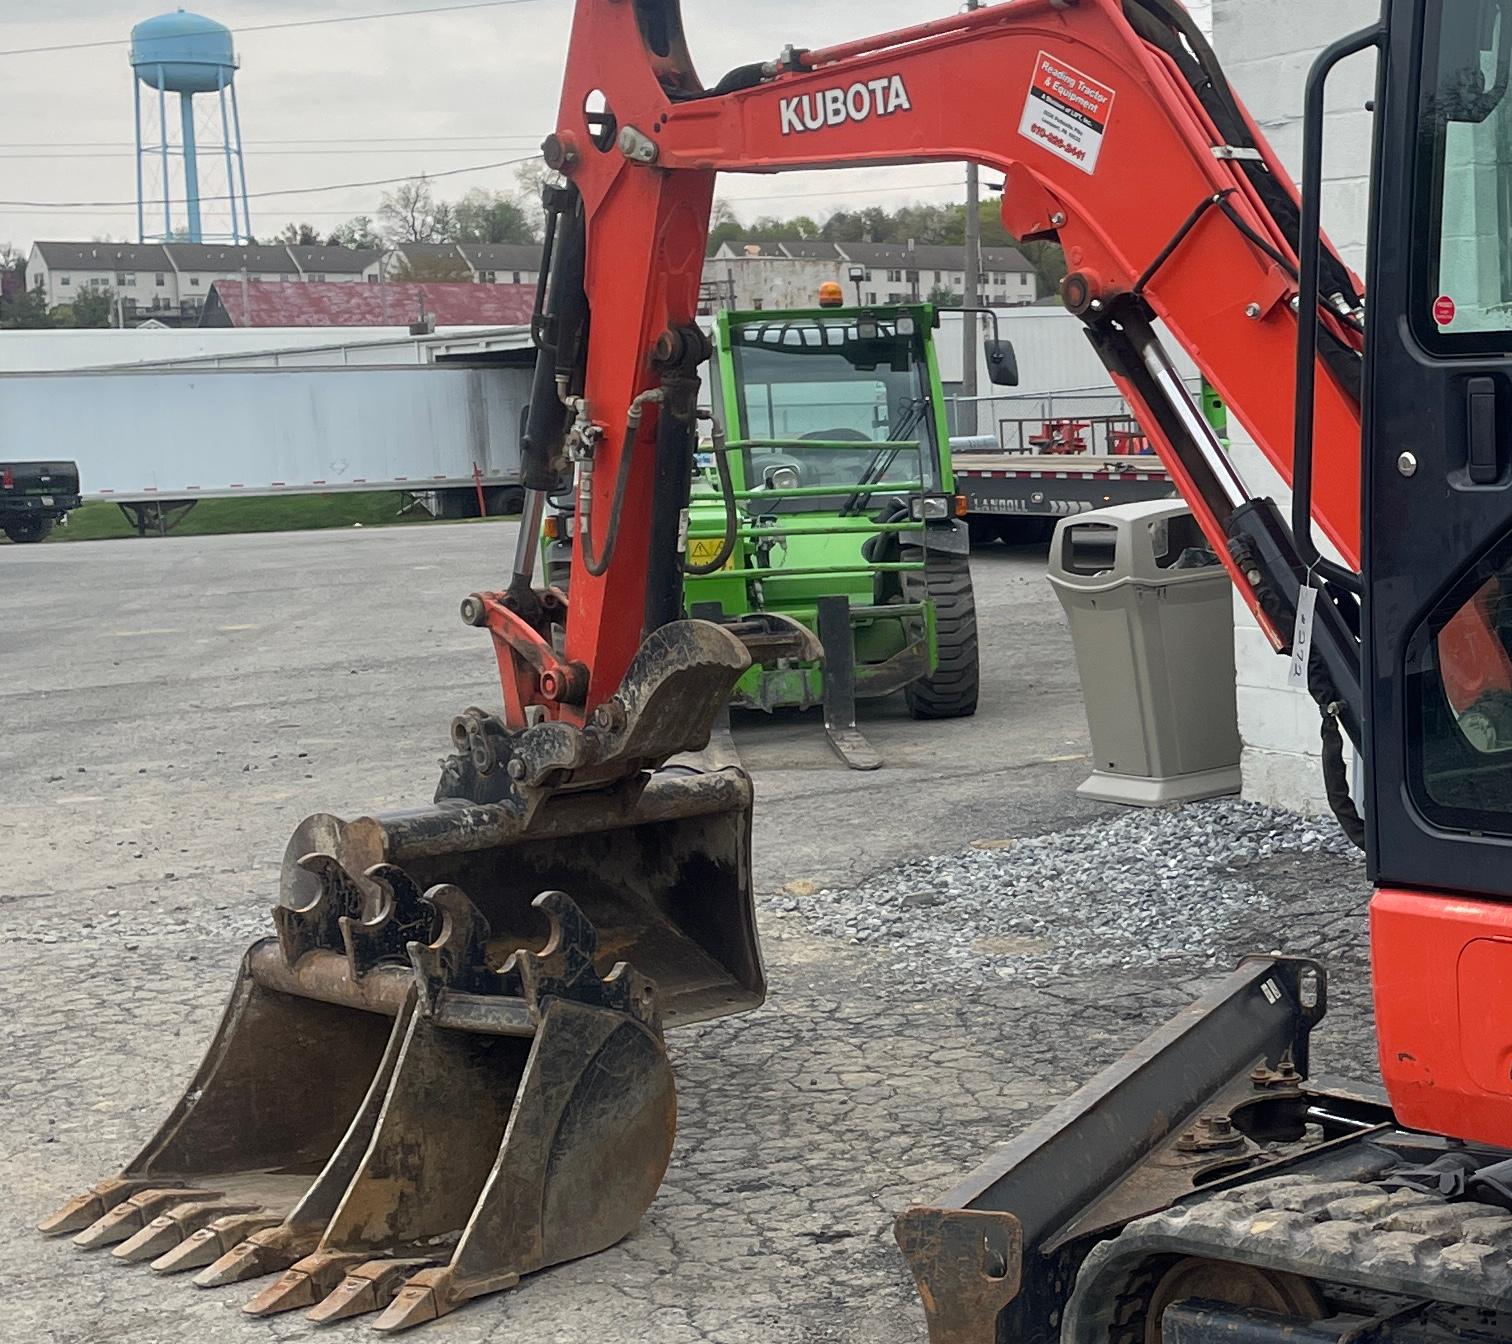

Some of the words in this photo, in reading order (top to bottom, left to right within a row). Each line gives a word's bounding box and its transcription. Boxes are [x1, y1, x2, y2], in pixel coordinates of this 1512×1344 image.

[1041, 61, 1076, 86] Reading
[1078, 80, 1107, 103] Tractor
[1052, 81, 1099, 113] Equipment
[779, 74, 911, 135] KUBOTA
